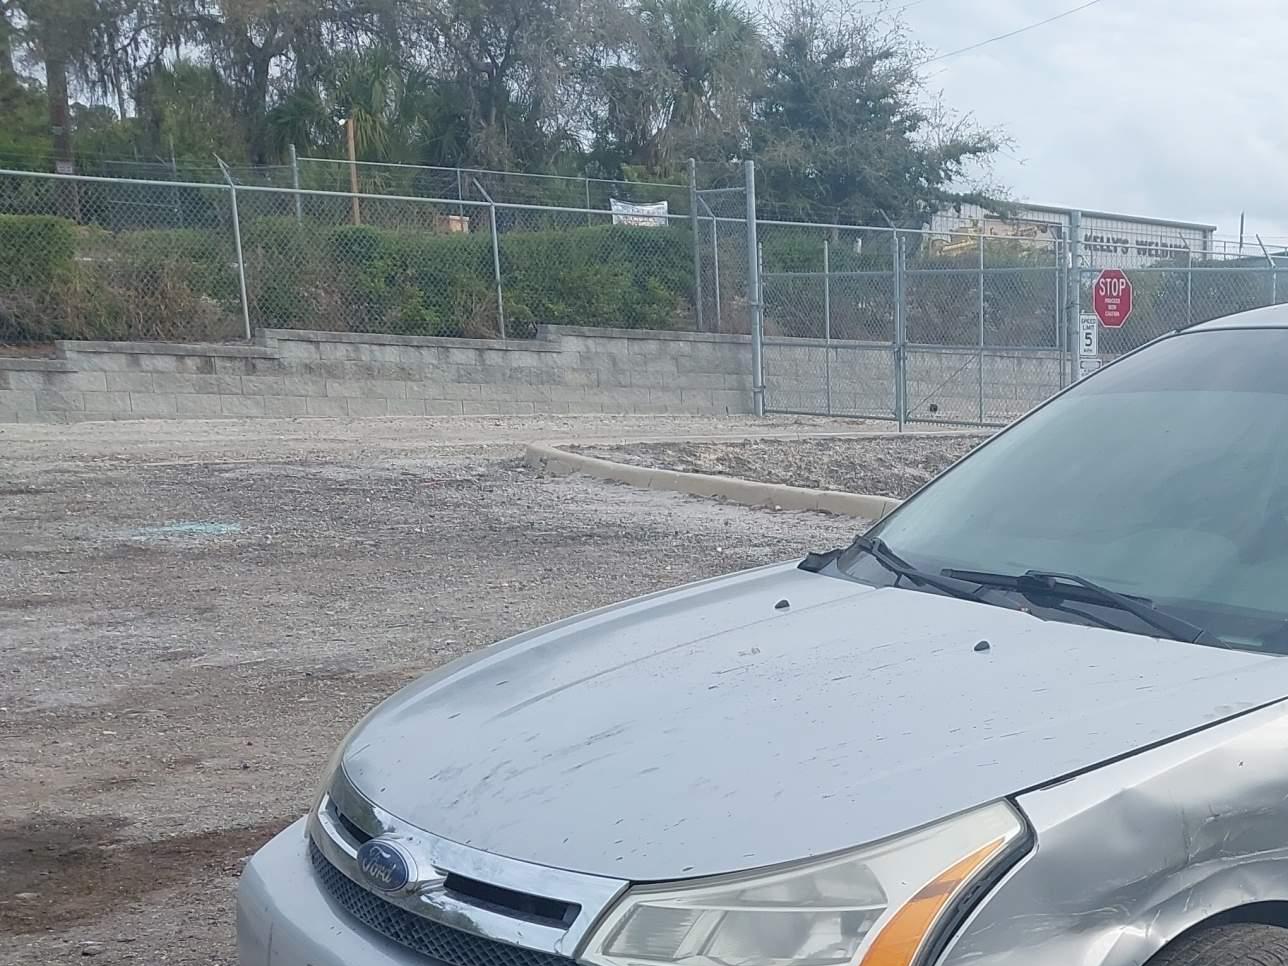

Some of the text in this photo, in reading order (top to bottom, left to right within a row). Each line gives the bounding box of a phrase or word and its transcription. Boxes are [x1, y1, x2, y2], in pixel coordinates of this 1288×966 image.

[1099, 278, 1126, 297] STOP
[1084, 332, 1093, 347] 5
[362, 845, 397, 884] Ford
